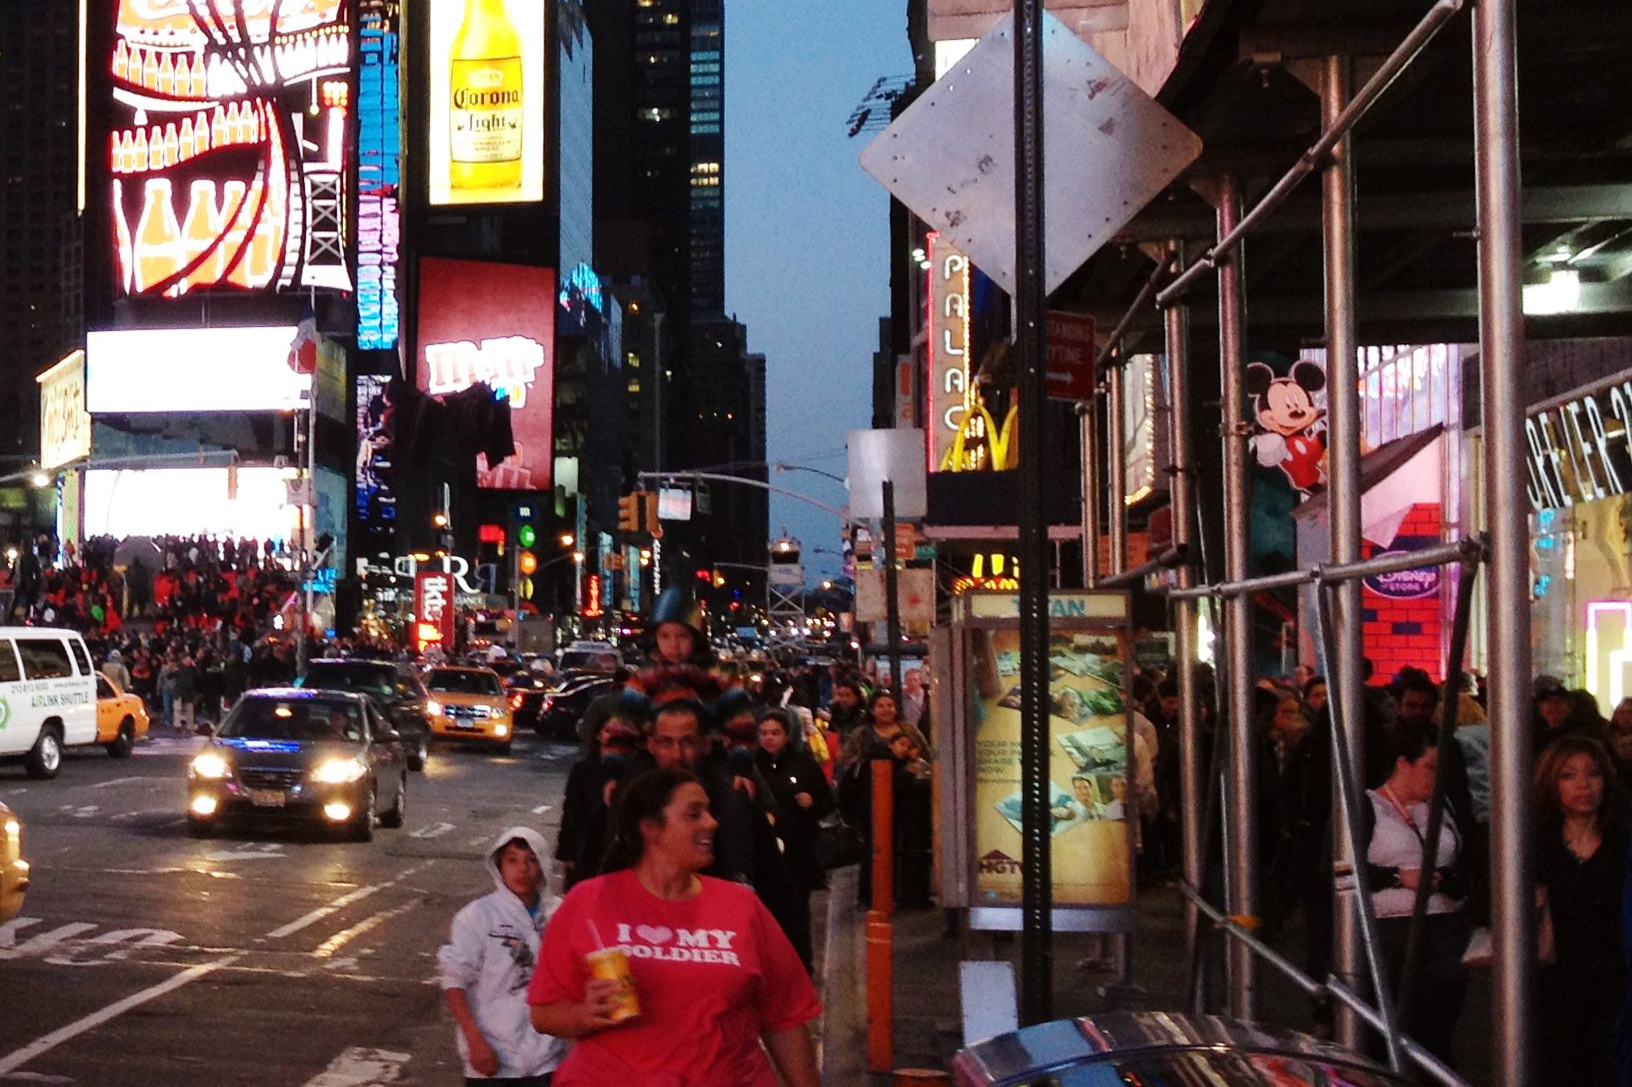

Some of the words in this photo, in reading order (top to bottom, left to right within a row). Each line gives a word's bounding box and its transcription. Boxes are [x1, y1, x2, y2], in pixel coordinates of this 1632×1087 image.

[453, 87, 520, 112] Corona
[616, 923, 633, 943] I
[675, 928, 737, 950] MY
